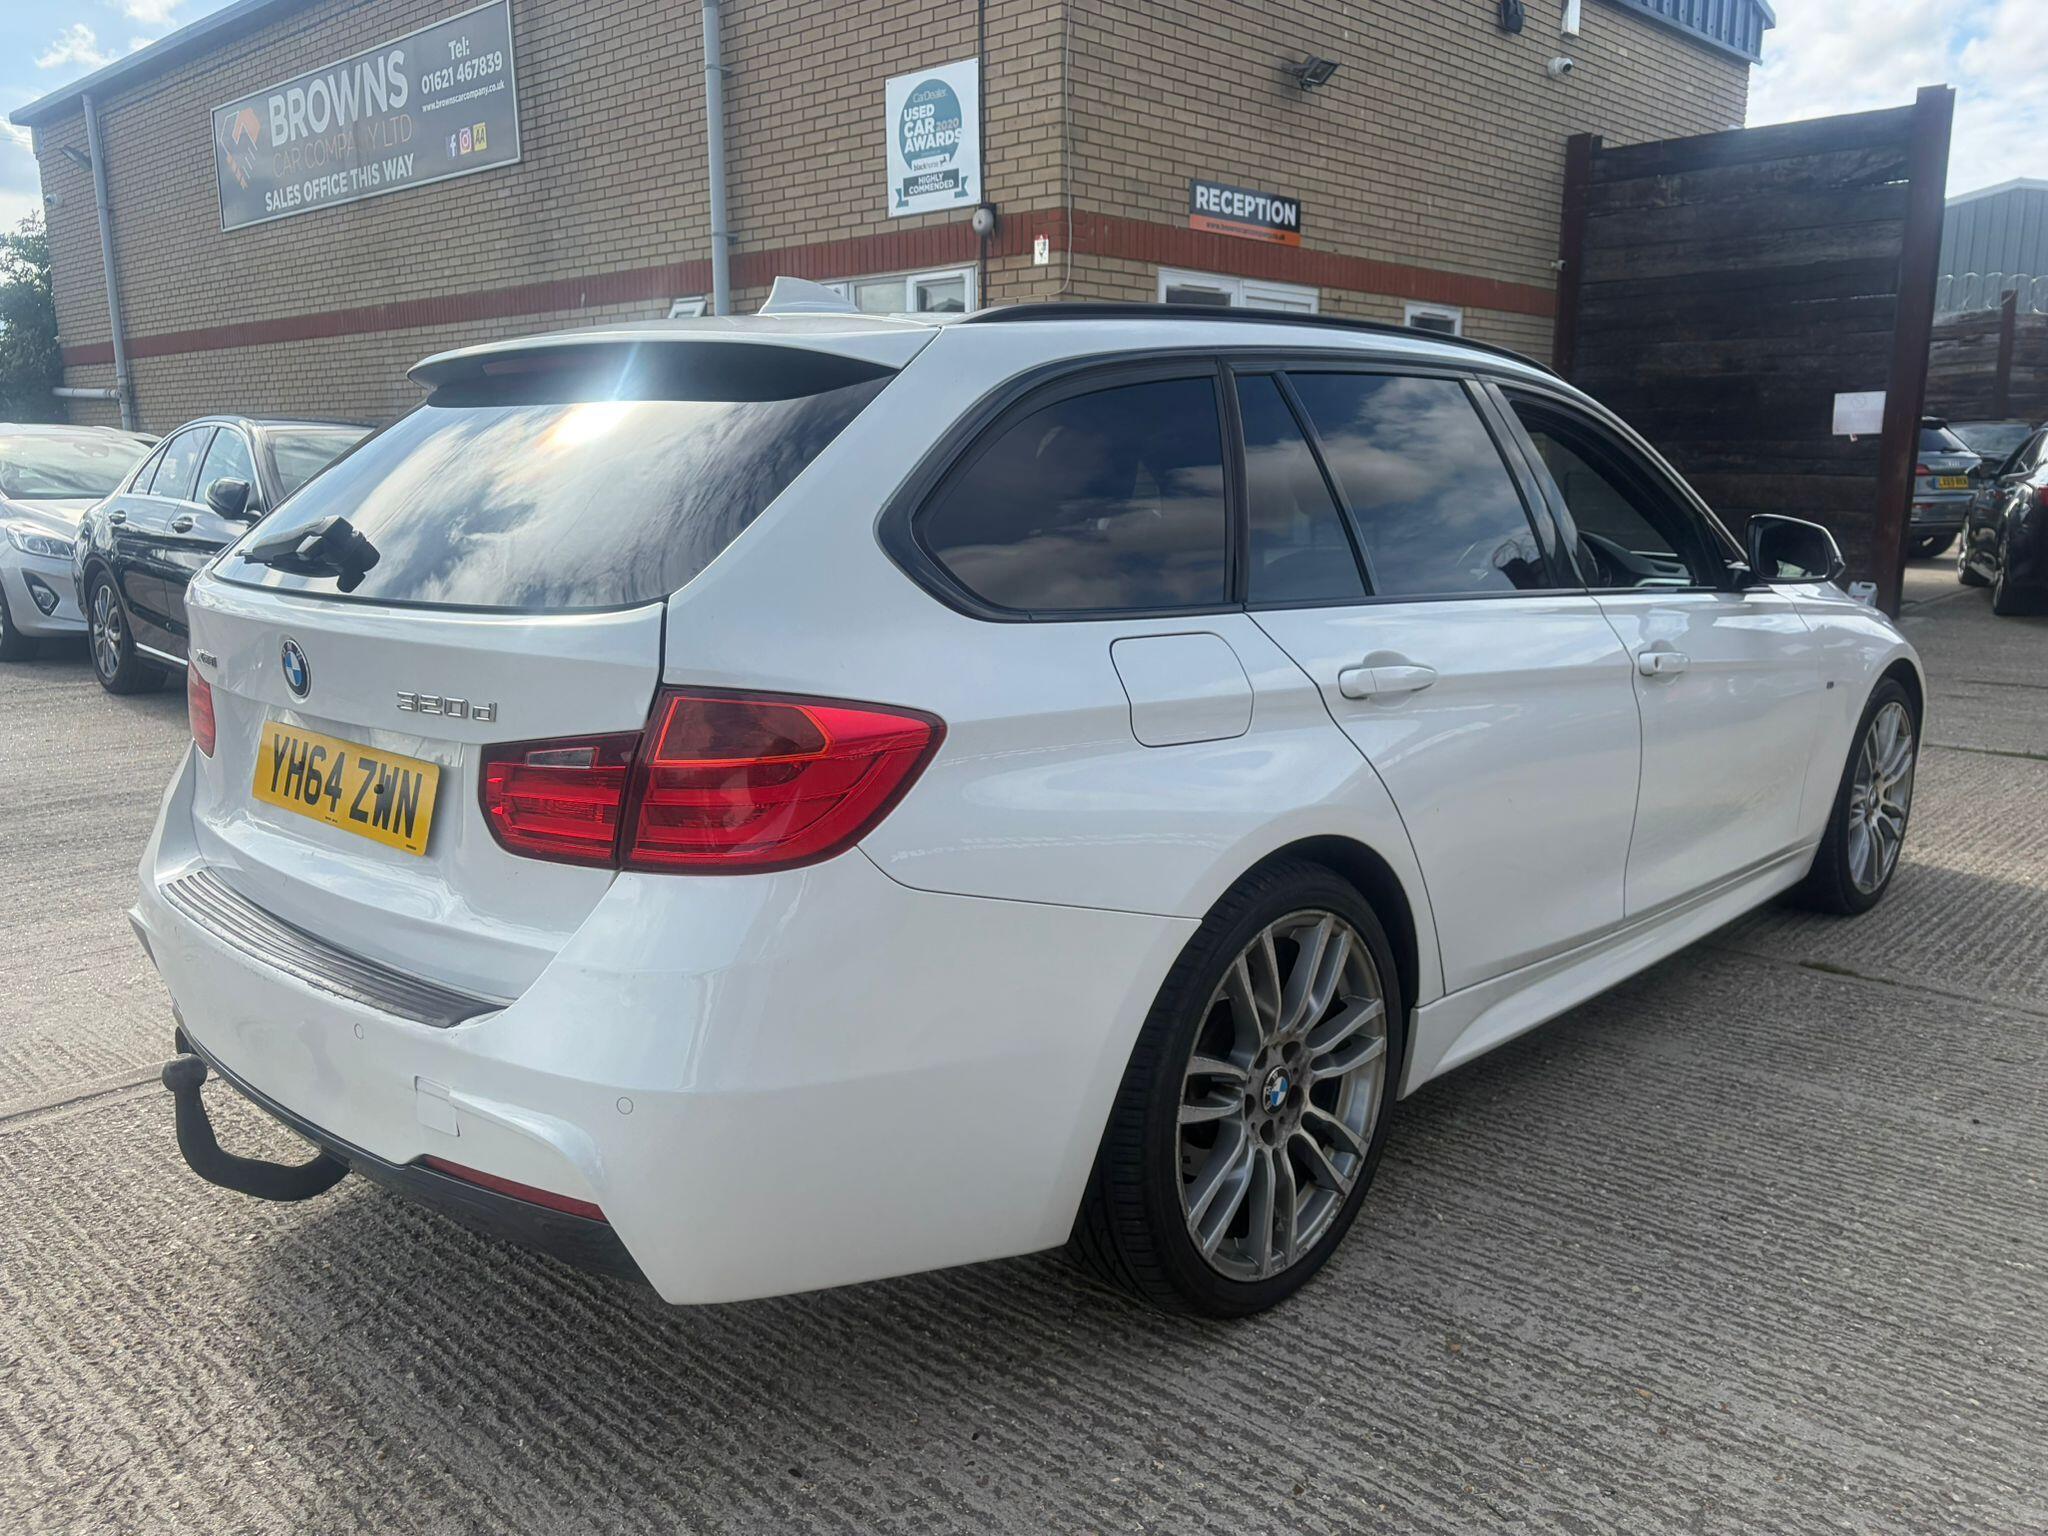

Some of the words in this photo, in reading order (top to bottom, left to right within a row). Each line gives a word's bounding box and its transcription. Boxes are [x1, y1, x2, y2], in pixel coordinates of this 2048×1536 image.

[448, 36, 470, 60] Tel:
[421, 66, 454, 94] 01621
[456, 51, 503, 83] 467839
[268, 50, 409, 147] BROWNS
[903, 103, 935, 122] USED
[304, 123, 378, 169] COMPAY
[382, 114, 413, 148] LTD
[903, 117, 935, 138] CAR
[904, 127, 963, 154] AWARDS
[265, 184, 301, 212] SALES
[303, 172, 348, 202] OFFICE
[350, 163, 380, 190] THIS
[382, 153, 414, 182] WAY
[908, 179, 954, 195] COMMENDED
[918, 172, 944, 186] HIGHLY
[1196, 185, 1297, 227] RECEPTION
[271, 733, 345, 813] YH64
[349, 756, 423, 839] ZWN
